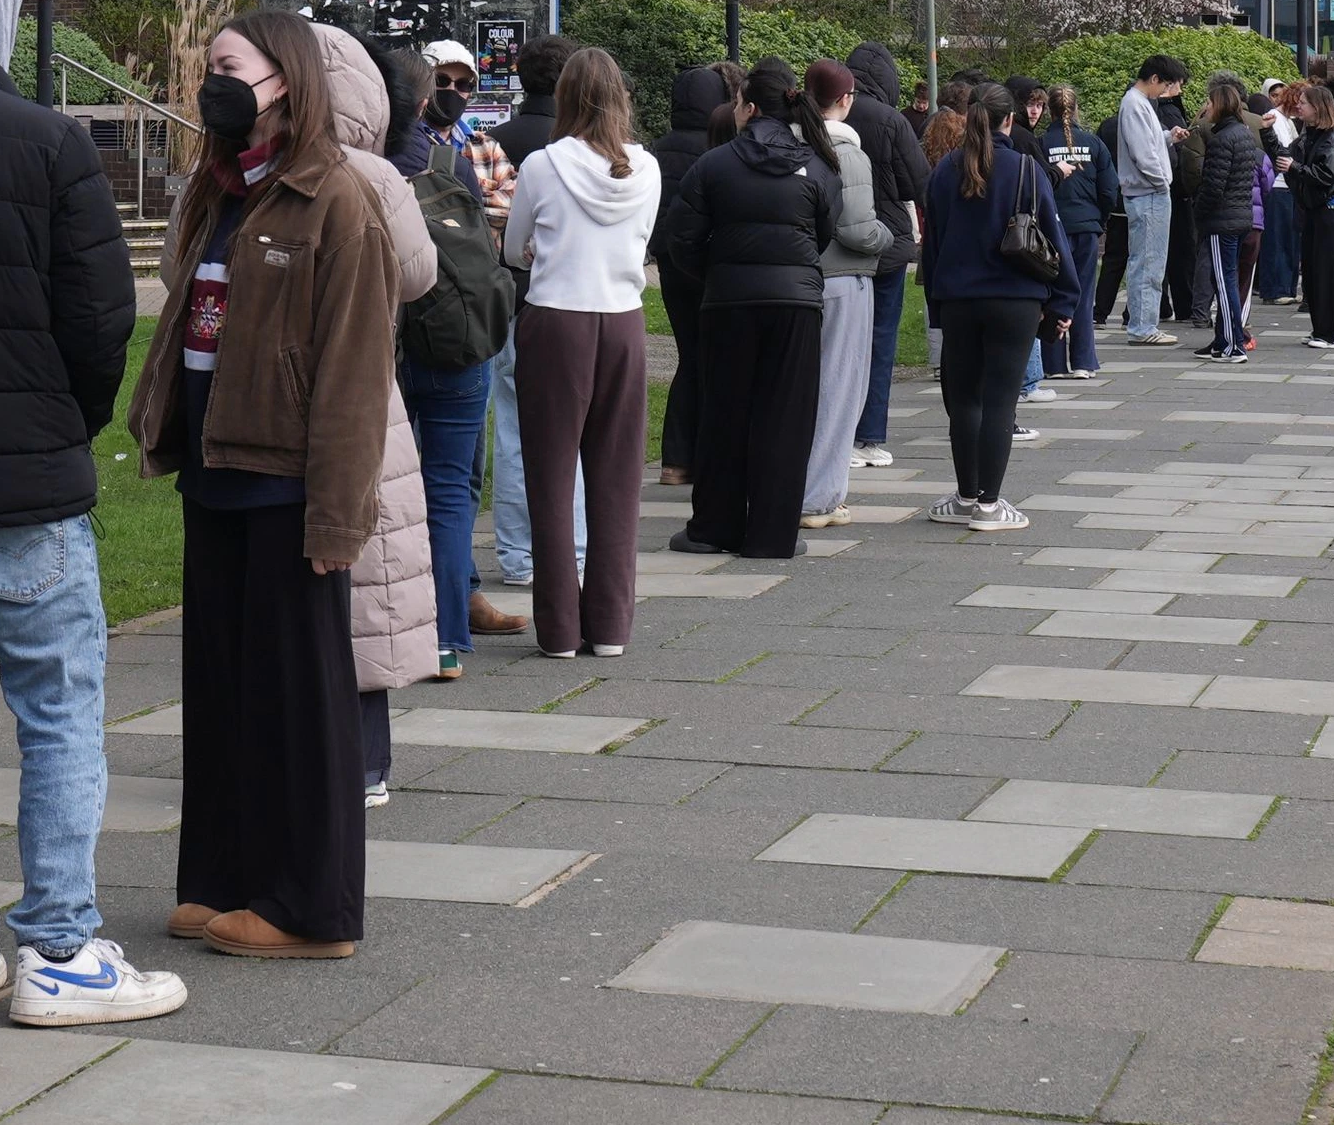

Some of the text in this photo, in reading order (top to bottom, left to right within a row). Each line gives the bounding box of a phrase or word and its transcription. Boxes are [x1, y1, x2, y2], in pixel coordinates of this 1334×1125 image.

[488, 29, 514, 38] COLOUR
[1048, 146, 1089, 155] UNIVERITY OF
[1048, 155, 1063, 163] KENT
